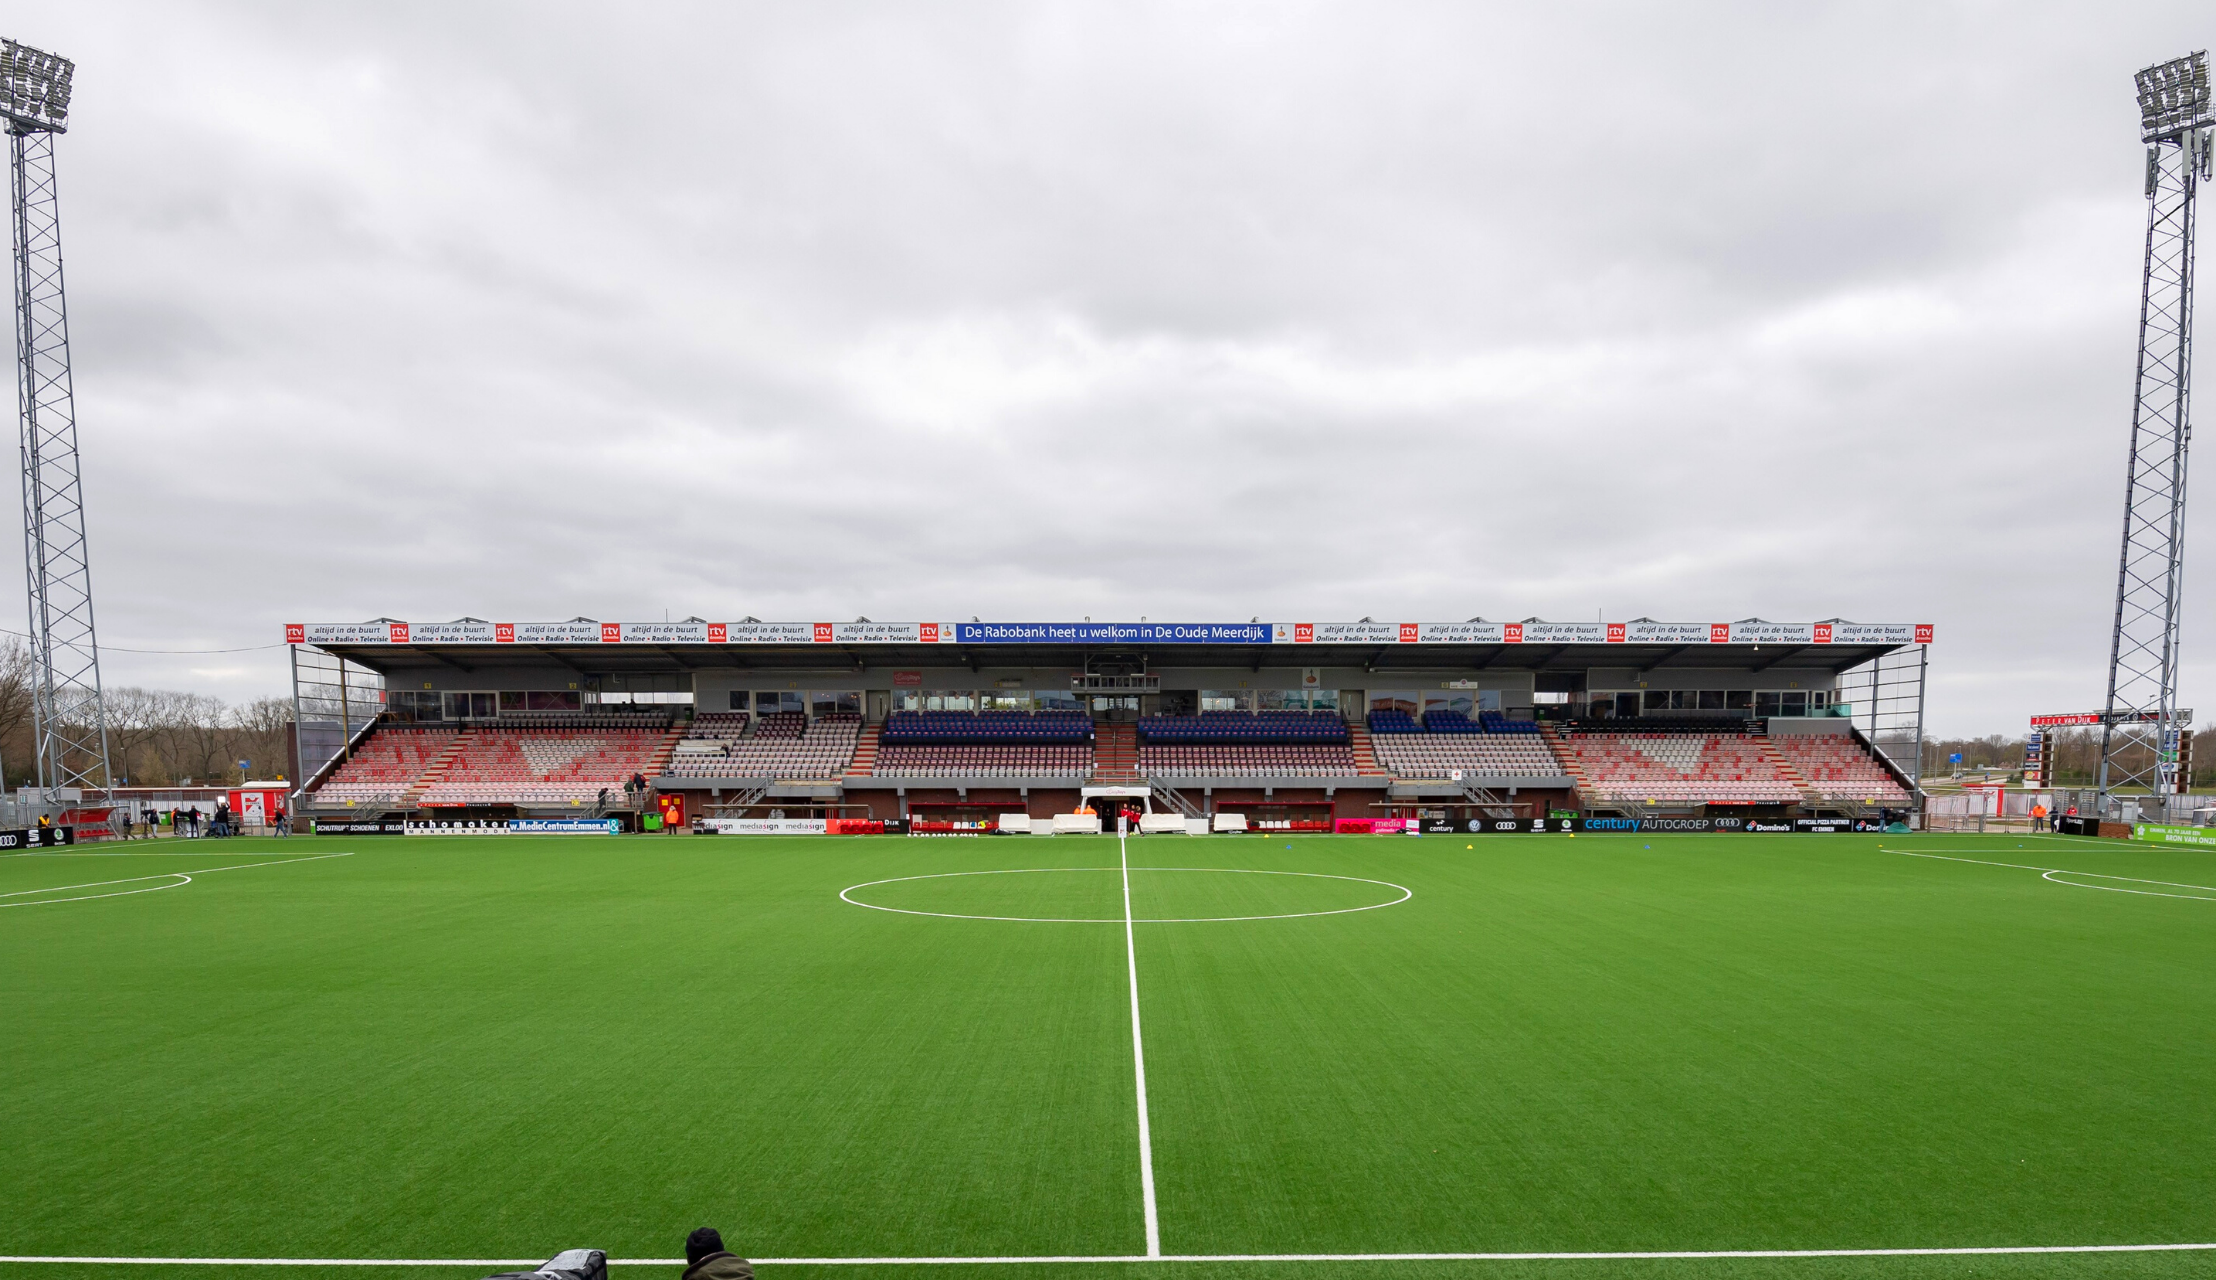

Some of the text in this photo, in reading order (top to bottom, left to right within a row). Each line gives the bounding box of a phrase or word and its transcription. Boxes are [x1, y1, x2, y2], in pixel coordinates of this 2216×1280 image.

[288, 628, 302, 636] rtv
[315, 627, 334, 635] altijd
[392, 627, 406, 636] rtv
[420, 626, 440, 634] altijd
[497, 627, 512, 635] rtv
[525, 626, 545, 634] altijd
[603, 627, 618, 635] rtv
[632, 626, 652, 634] altijd
[709, 626, 724, 635] rtv
[738, 626, 758, 634] altijd
[815, 626, 830, 635] rtv
[844, 626, 864, 634] altijd
[921, 626, 936, 635] rtv
[965, 626, 1264, 640] De Rabobank heet u welkom in De Oude Meerdijk
[1296, 626, 1311, 635] rtv
[1325, 626, 1344, 634] altijd
[1401, 626, 1416, 635] rtv
[1430, 626, 1449, 634] altijd
[1505, 626, 1520, 635] rtv
[1533, 626, 1552, 634] altijd
[1609, 627, 1623, 635] rtv
[1637, 626, 1656, 634] altijd
[1712, 627, 1727, 635] rtv
[1740, 626, 1759, 634] altijd
[1815, 627, 1829, 636] rtv
[1843, 627, 1862, 635] altijd
[1917, 628, 1930, 636] rtv
[740, 822, 778, 830] mediasign
[786, 822, 824, 830] mediasign
[1585, 818, 1709, 833] century AUTOGROEP
